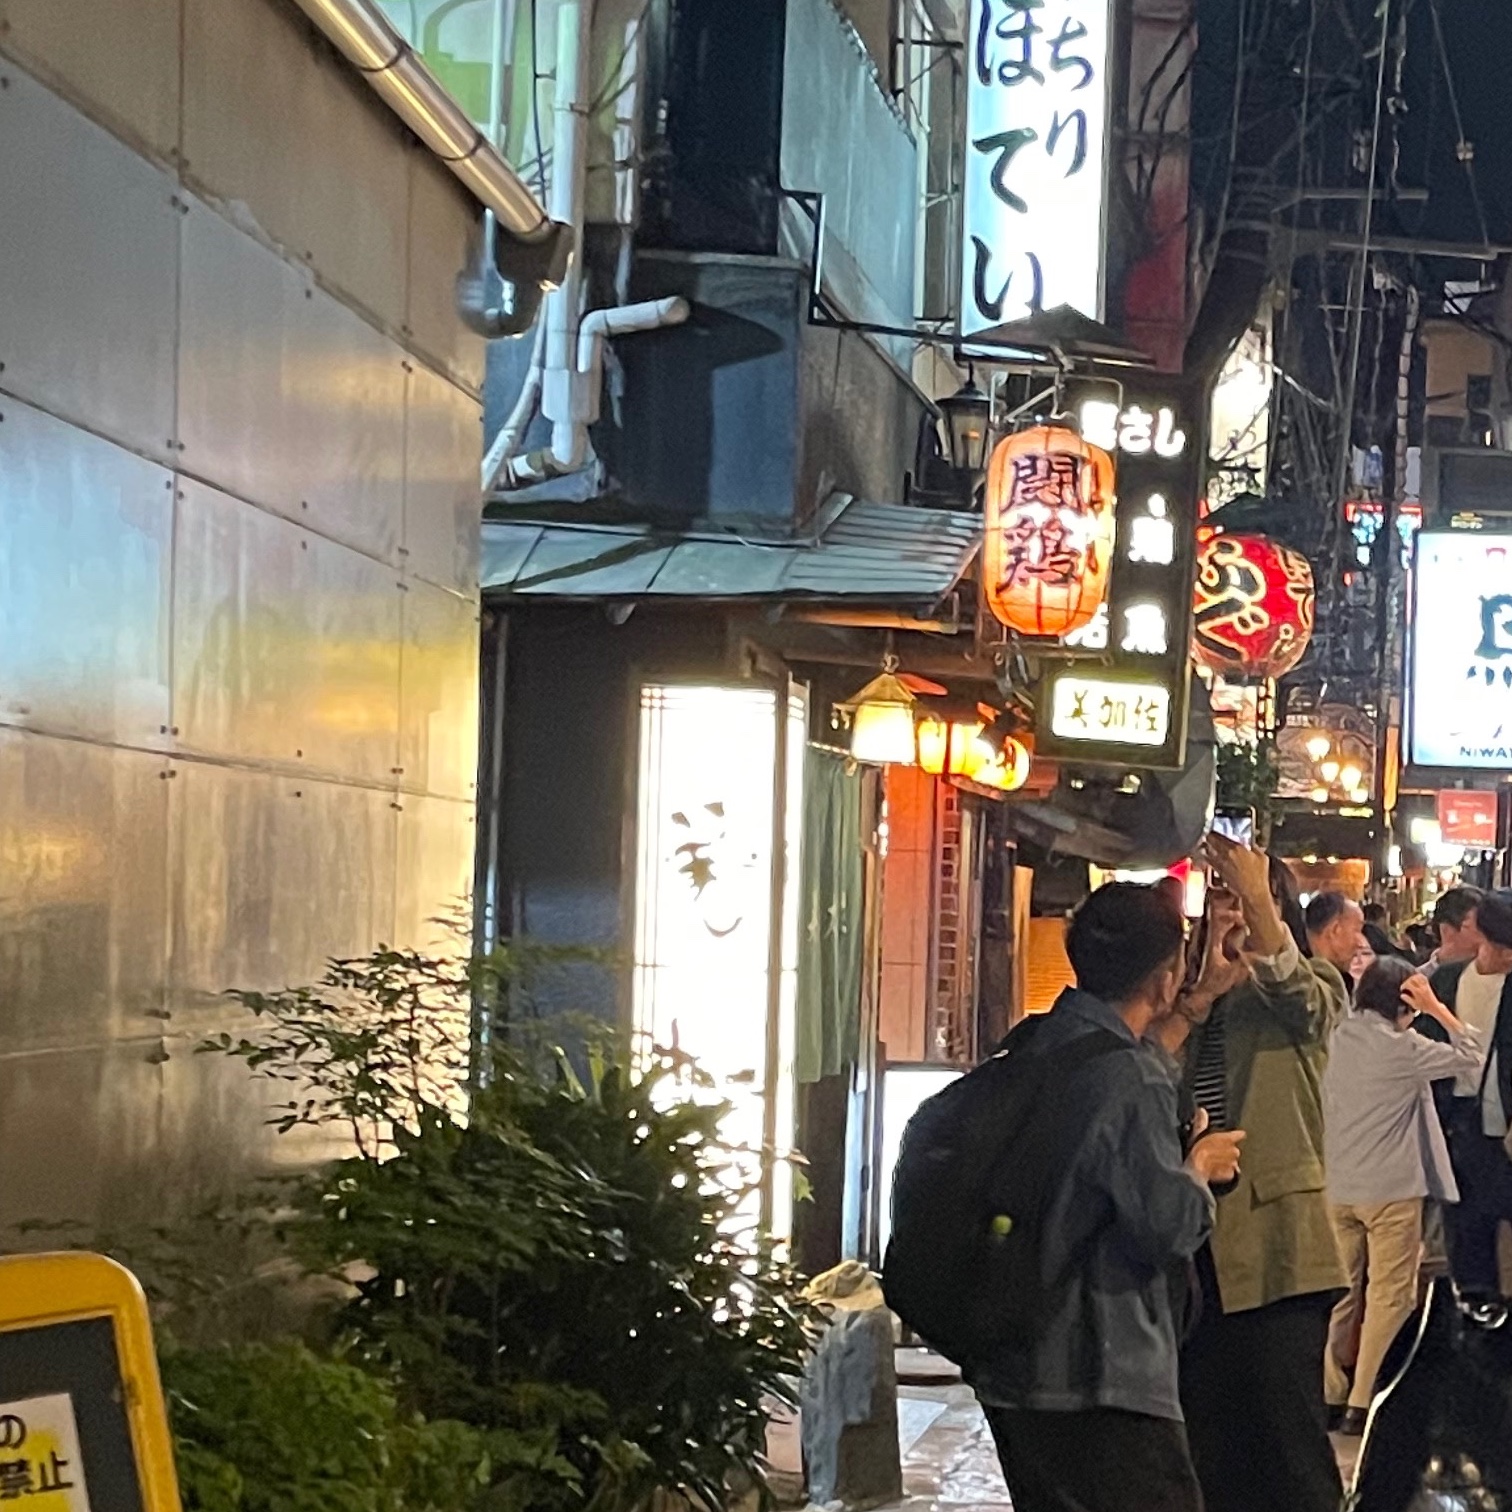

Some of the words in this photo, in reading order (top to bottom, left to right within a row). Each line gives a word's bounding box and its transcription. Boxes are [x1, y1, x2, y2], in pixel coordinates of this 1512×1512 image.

[971, 0, 1046, 322] ほてい
[1082, 401, 1186, 457] さし
